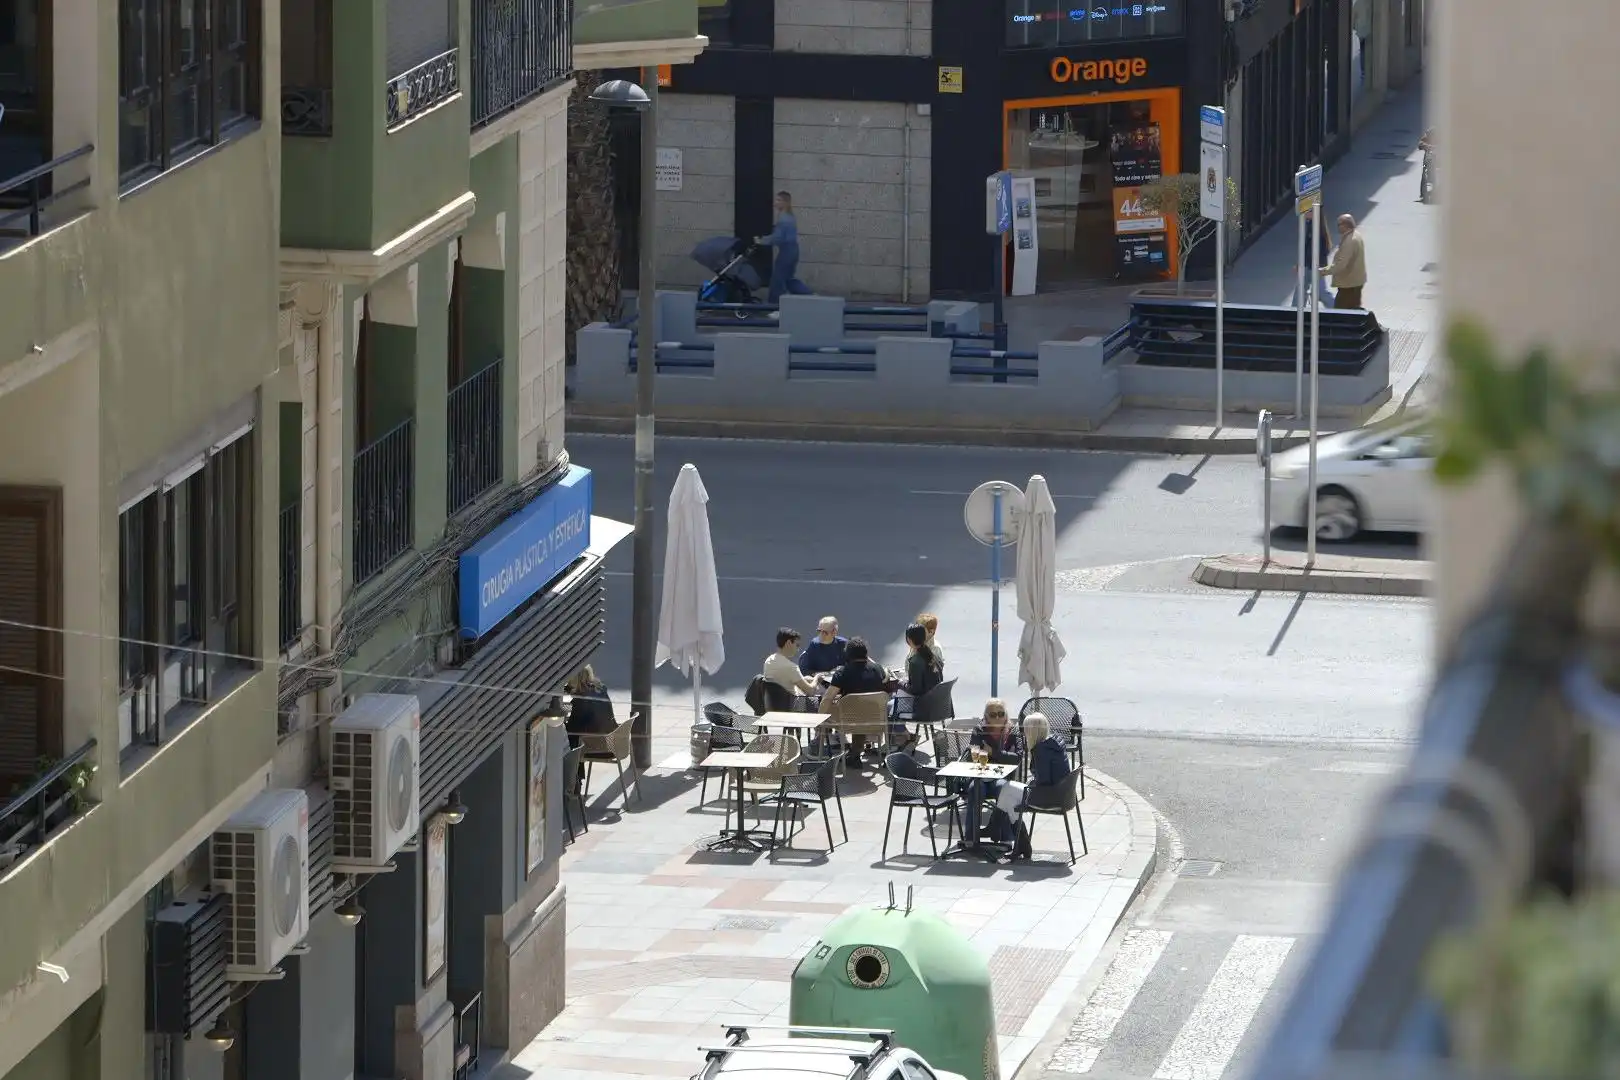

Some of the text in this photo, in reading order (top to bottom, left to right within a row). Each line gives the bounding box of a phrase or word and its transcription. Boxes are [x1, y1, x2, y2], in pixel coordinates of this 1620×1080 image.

[1051, 56, 1147, 84] Orange
[514, 537, 548, 582] PLÁSTICA
[548, 530, 555, 552] Y
[555, 508, 586, 550] ESTÉTICA
